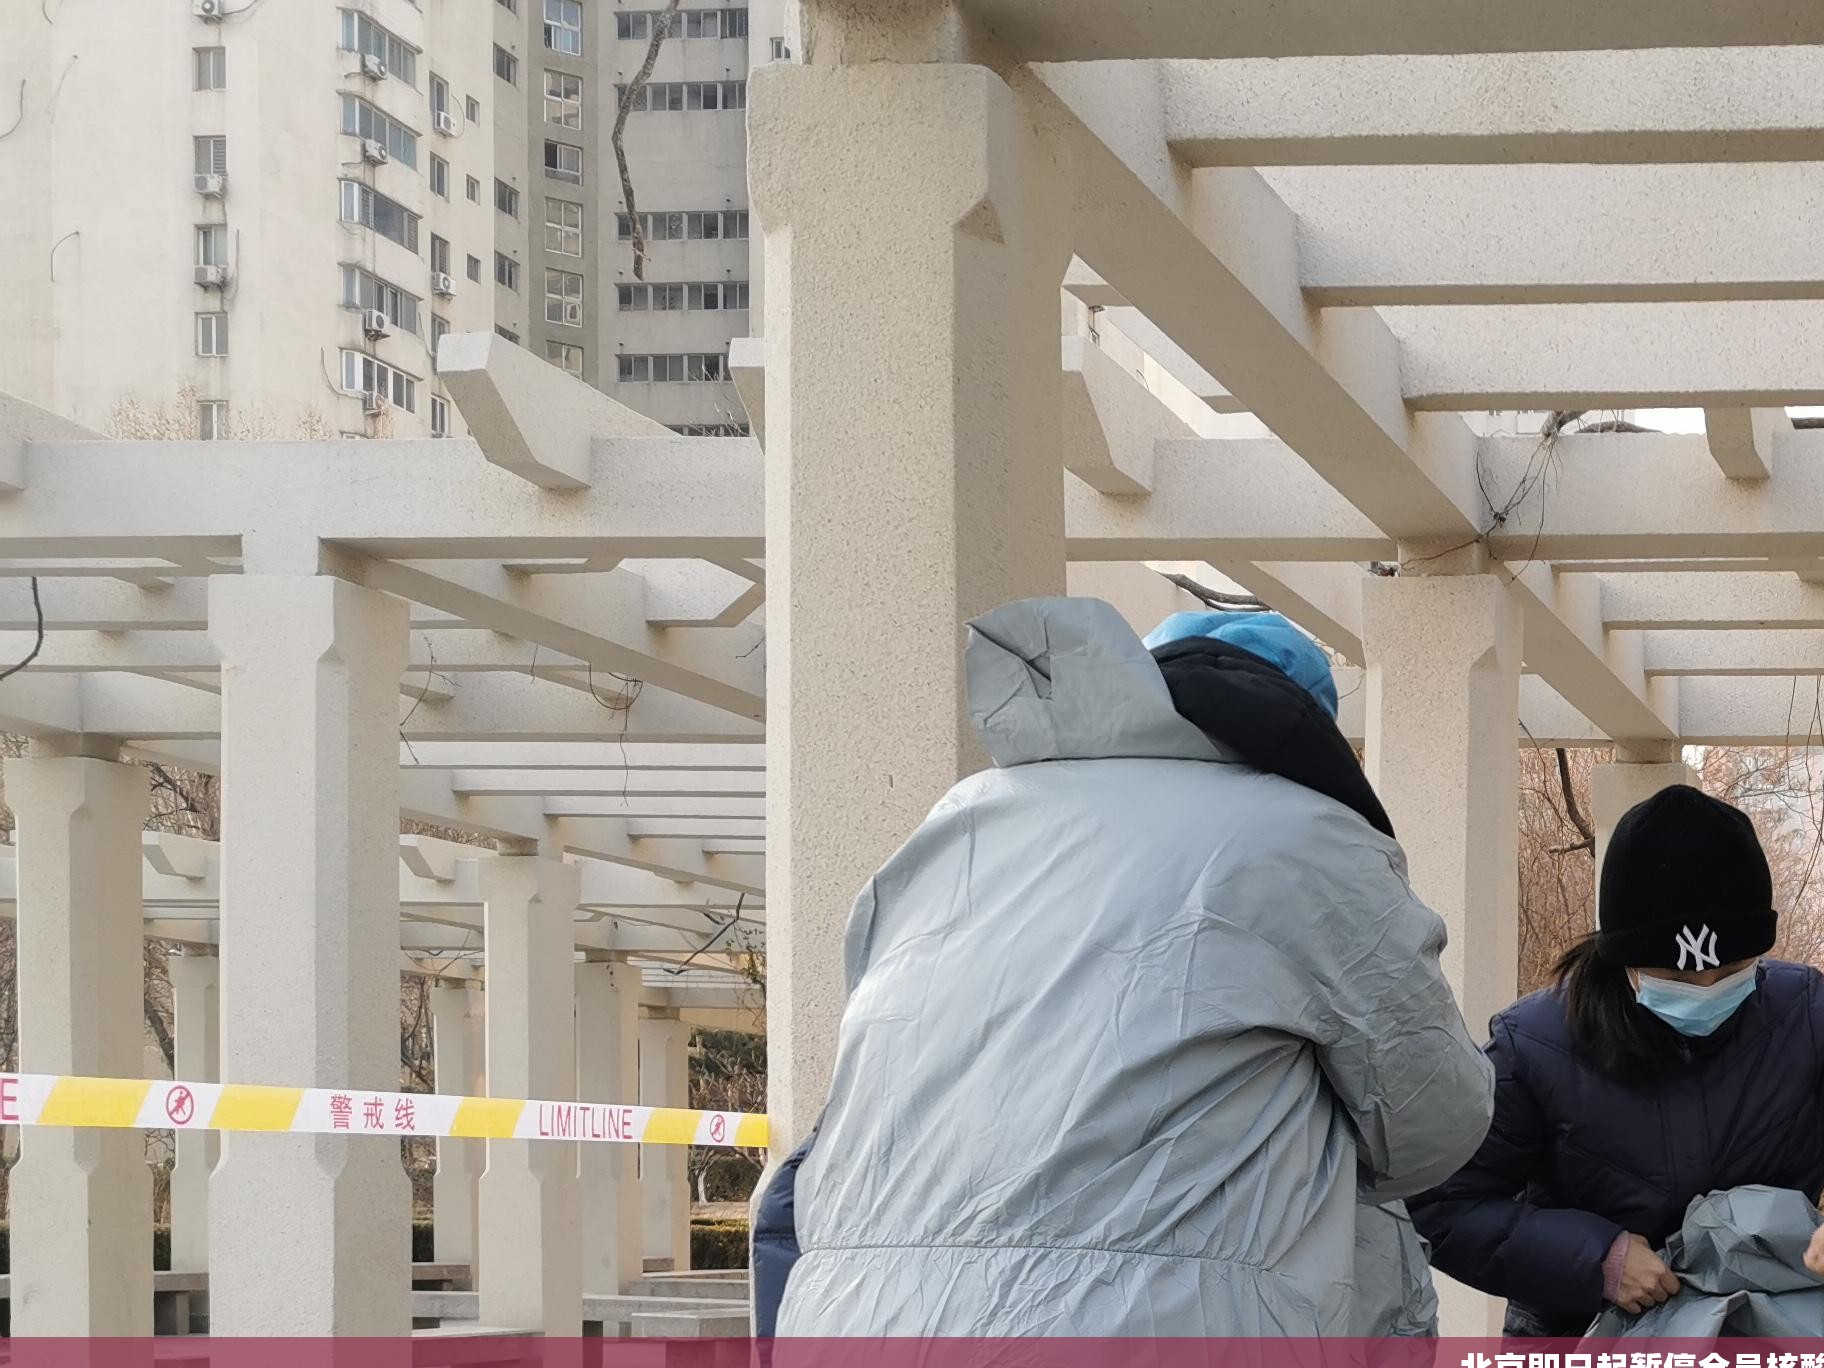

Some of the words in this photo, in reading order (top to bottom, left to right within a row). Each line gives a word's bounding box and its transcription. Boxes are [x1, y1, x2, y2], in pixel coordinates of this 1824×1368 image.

[1675, 923, 1720, 972] NY
[330, 1094, 416, 1132] 警戒线
[538, 1104, 634, 1140] LIMITLINE
